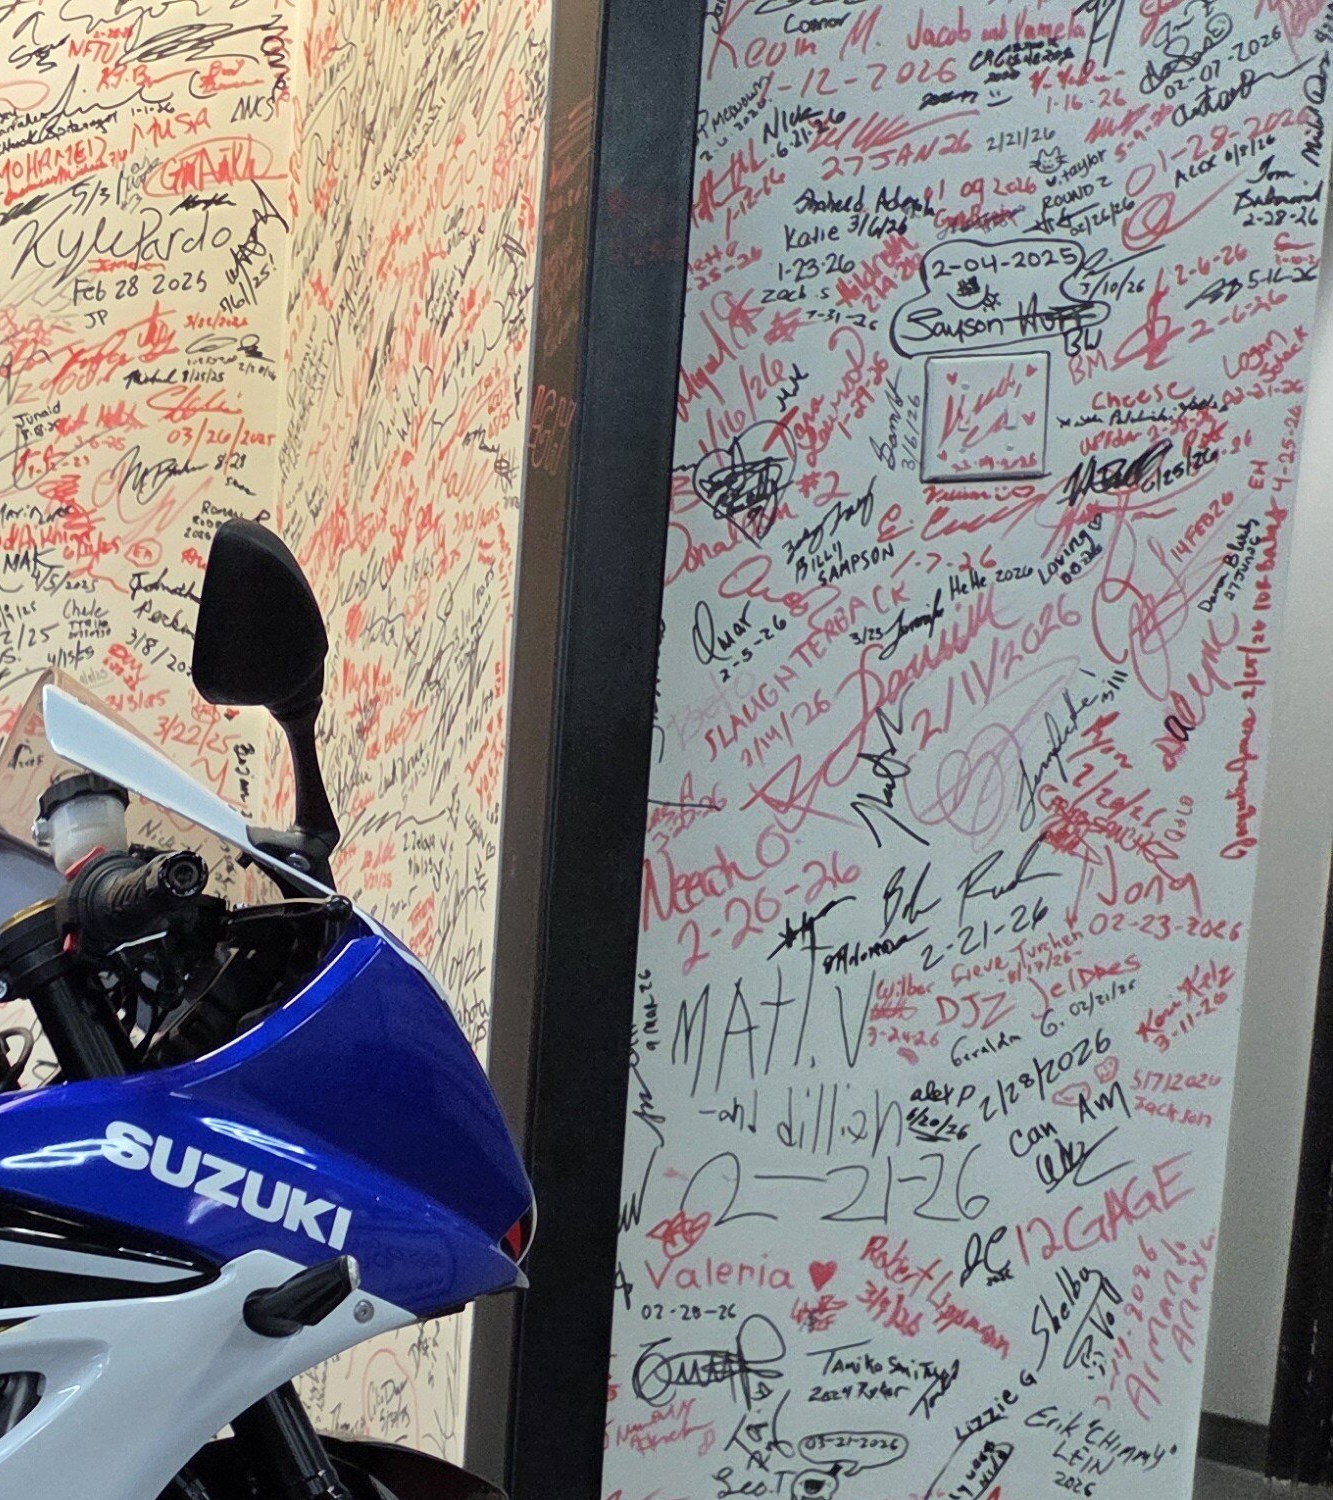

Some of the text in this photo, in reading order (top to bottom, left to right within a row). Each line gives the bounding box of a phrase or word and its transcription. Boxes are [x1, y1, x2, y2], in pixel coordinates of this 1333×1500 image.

[931, 248, 1083, 278] 2-04-2025
[115, 278, 138, 297] 28
[99, 1117, 354, 1252] SUZUKI
[645, 1259, 795, 1291] Valeria
